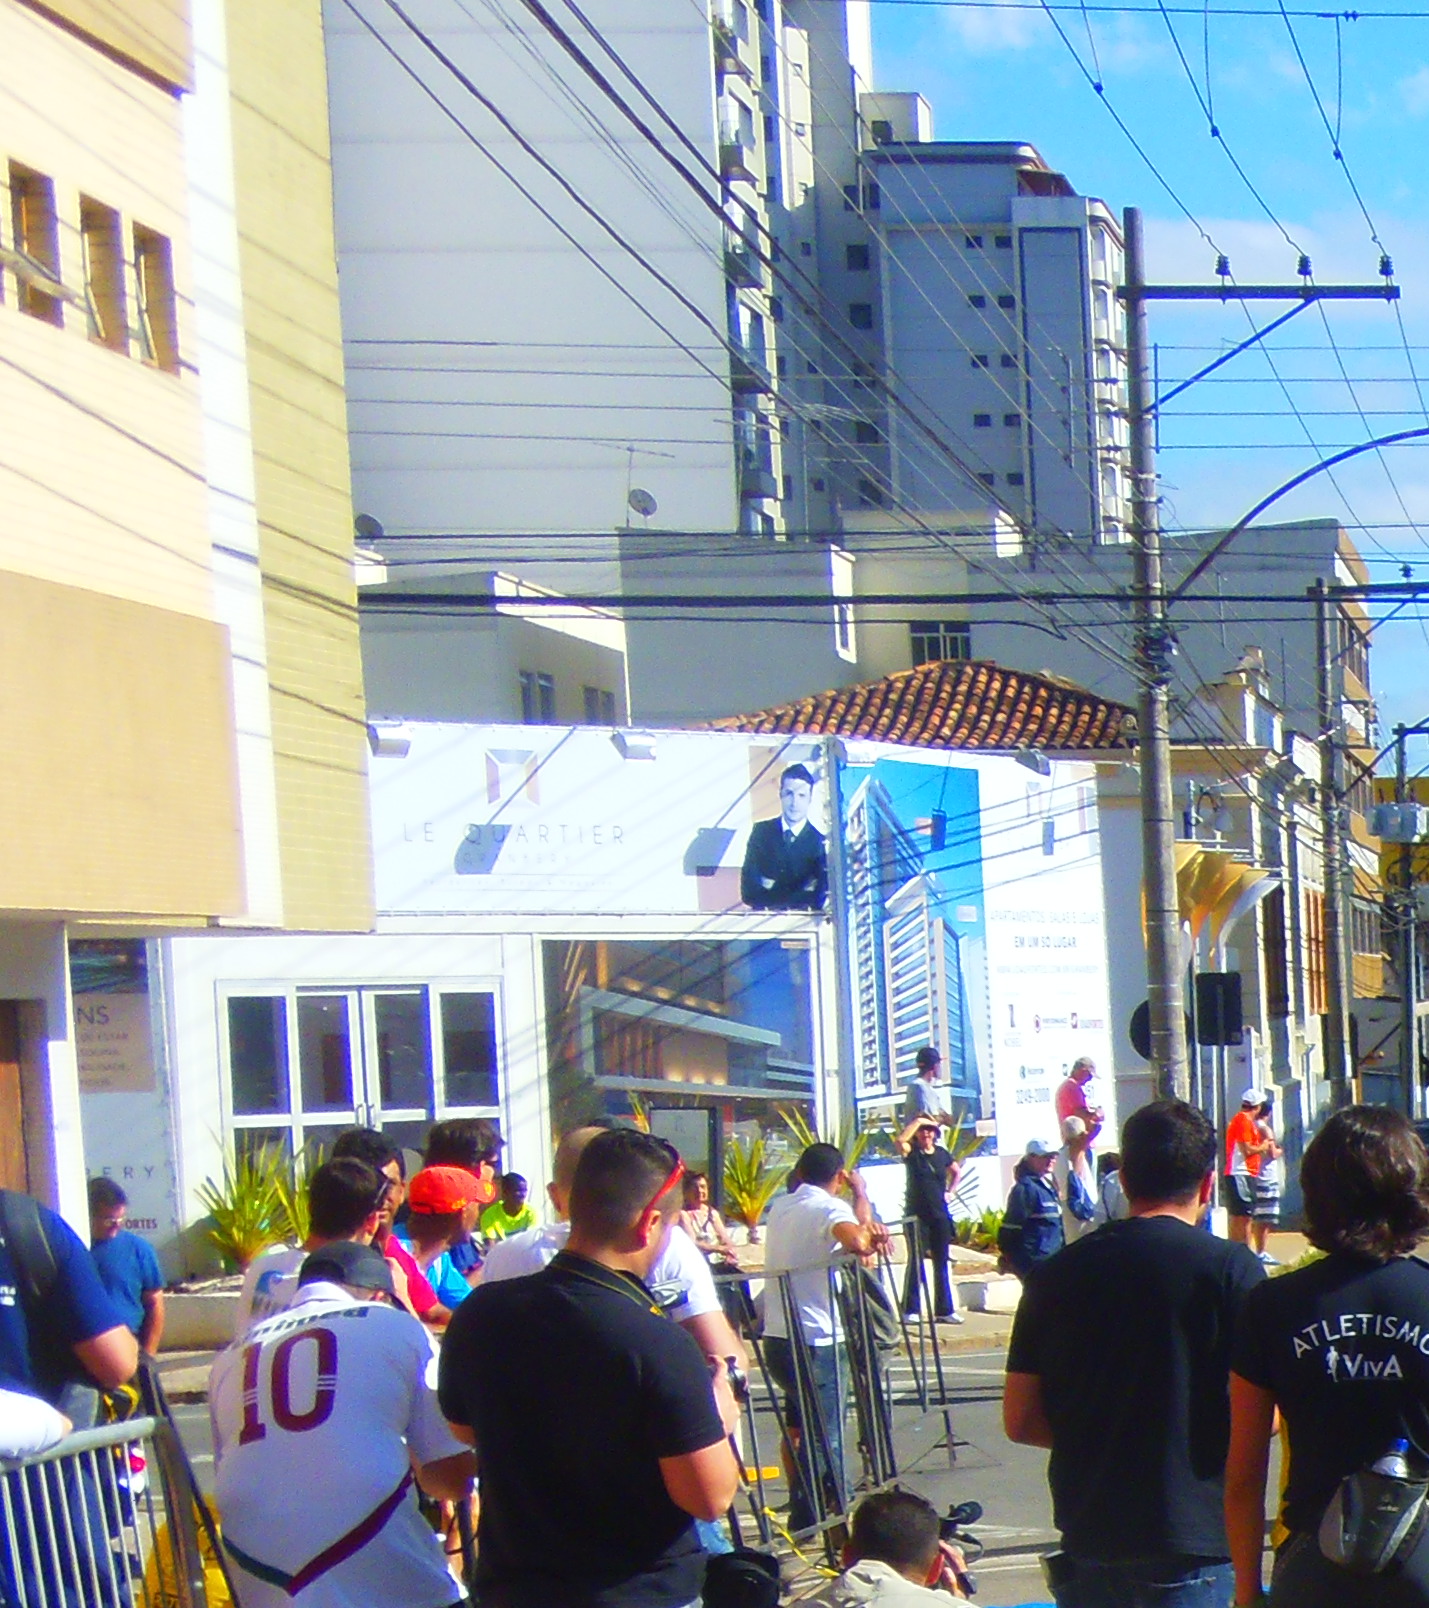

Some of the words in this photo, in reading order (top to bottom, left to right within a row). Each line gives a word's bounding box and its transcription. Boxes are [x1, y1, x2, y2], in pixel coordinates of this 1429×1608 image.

[403, 821, 435, 843] LE
[463, 822, 625, 846] QUARTIER
[239, 1328, 339, 1446] 10
